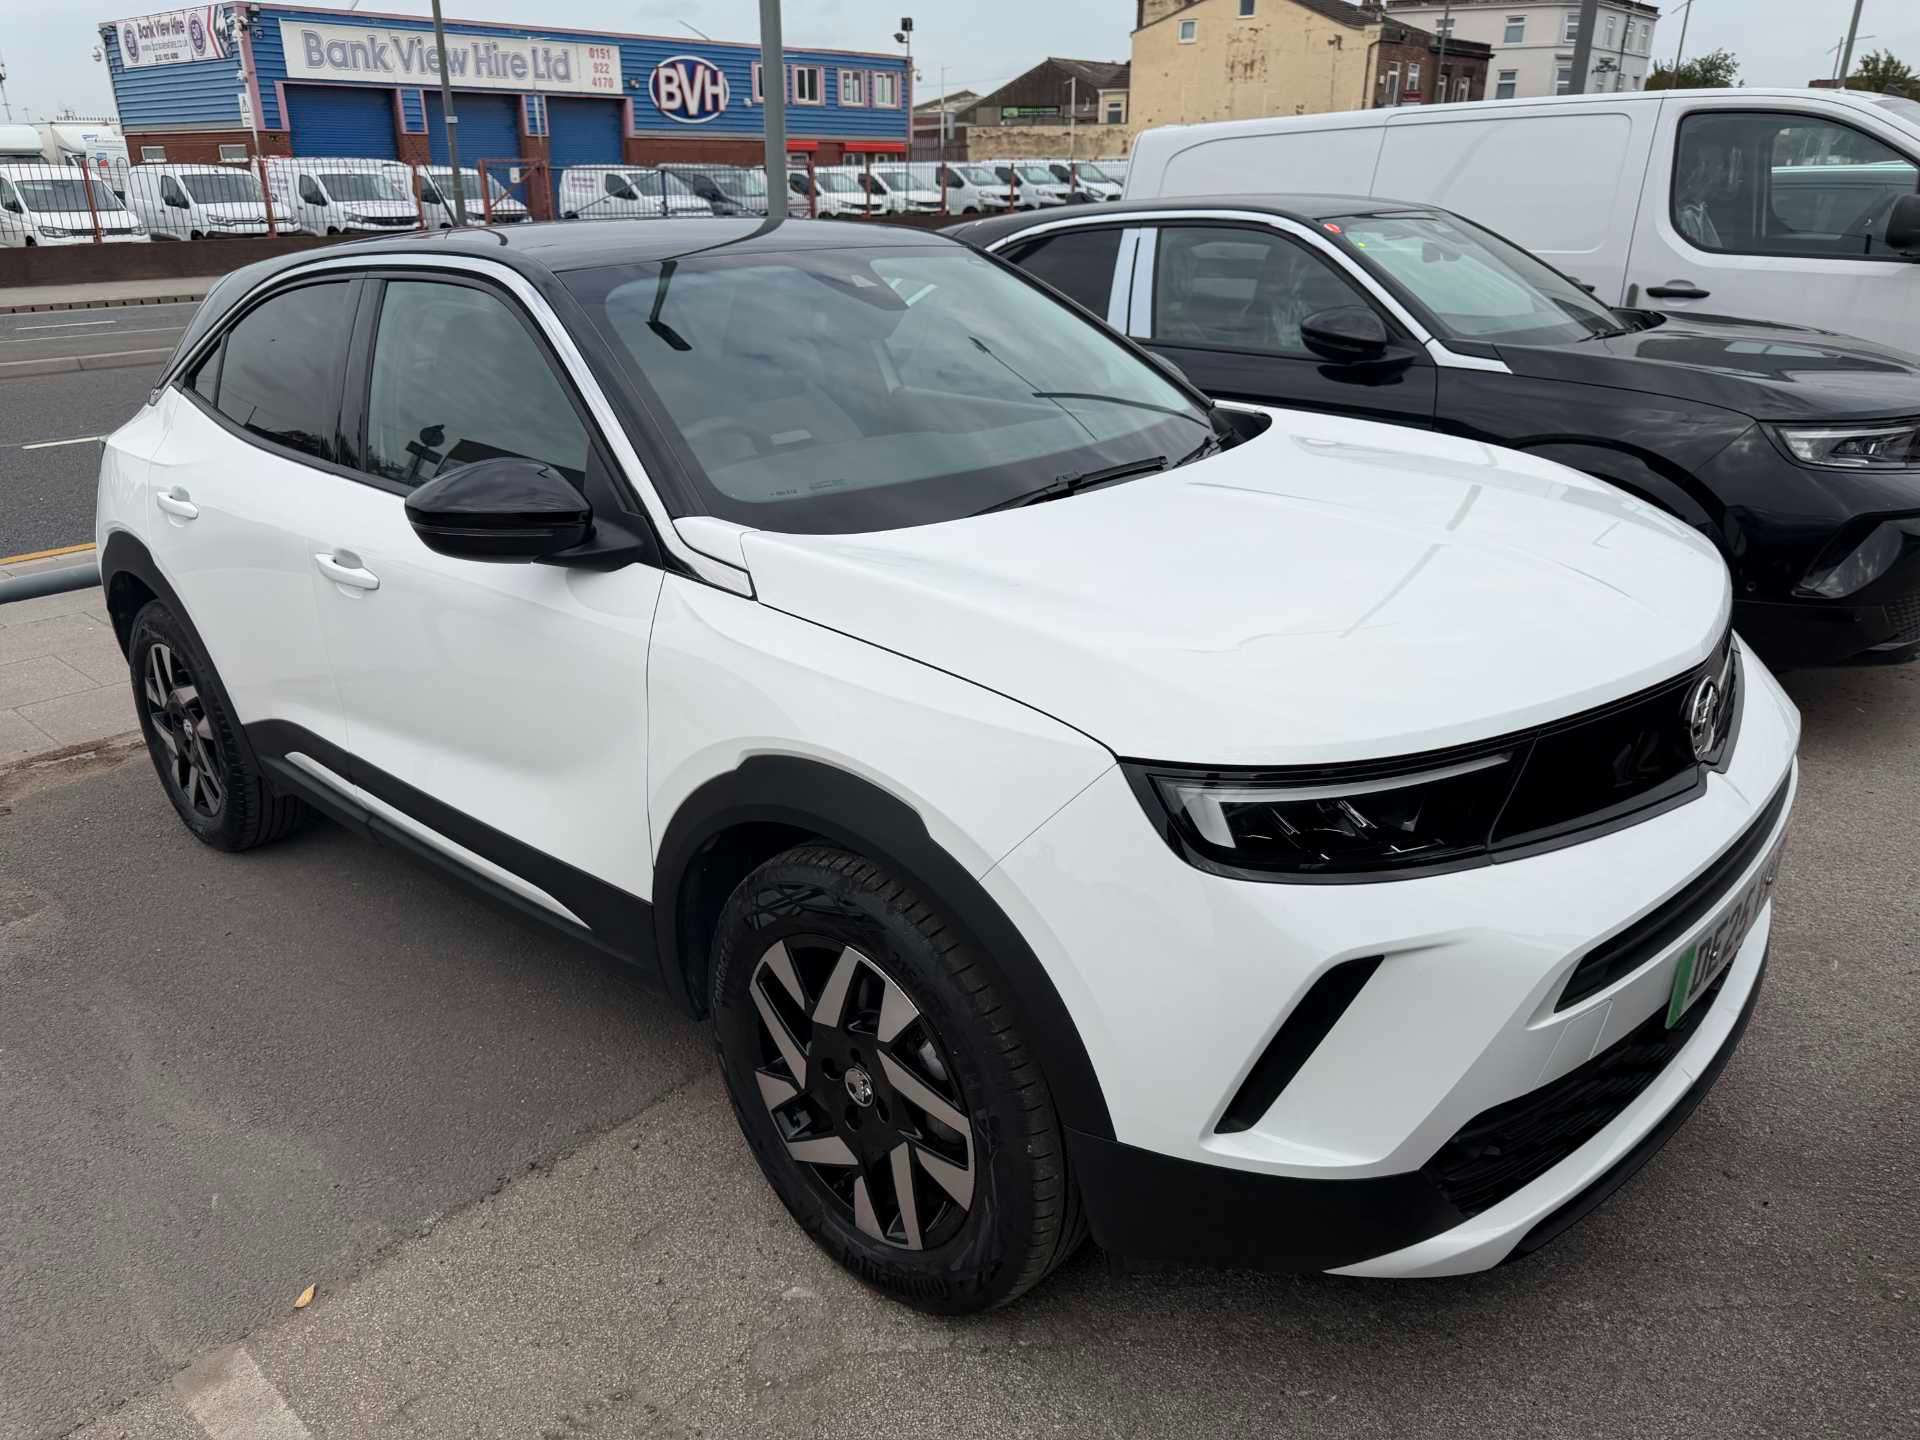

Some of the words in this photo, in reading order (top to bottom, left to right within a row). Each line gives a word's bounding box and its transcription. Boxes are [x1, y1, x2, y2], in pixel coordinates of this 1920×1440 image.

[137, 17, 157, 39] Bank
[154, 16, 171, 37] View
[170, 14, 185, 35] Hire
[301, 30, 393, 73] Bank
[391, 35, 469, 77] View
[471, 41, 530, 80] Hire
[530, 46, 573, 82] Ltd
[588, 47, 611, 60] 0151
[593, 62, 610, 74] 922
[592, 76, 614, 88] 4170
[656, 63, 726, 116] BVH
